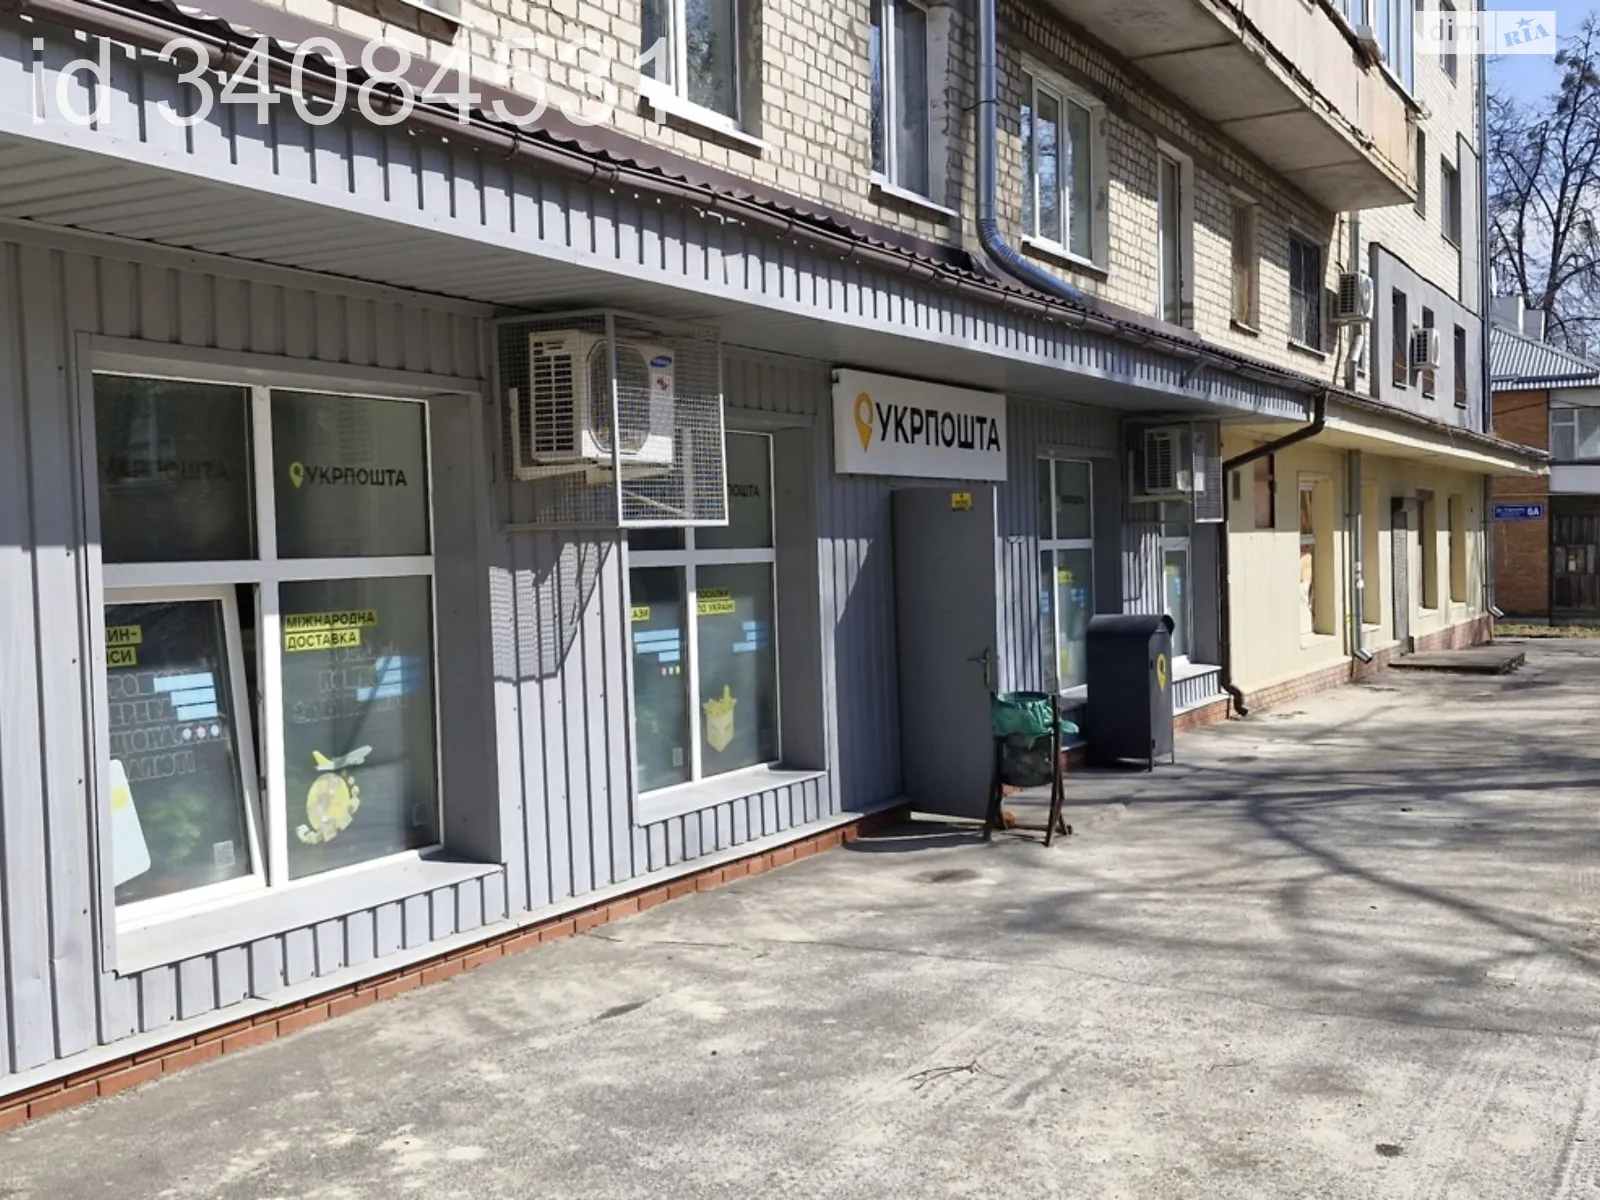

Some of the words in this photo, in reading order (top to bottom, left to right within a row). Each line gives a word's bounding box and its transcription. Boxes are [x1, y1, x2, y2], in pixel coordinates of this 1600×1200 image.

[875, 402, 1001, 452] УКРПОШТА
[305, 466, 408, 487] УКРПОШТА
[286, 611, 375, 629] МІЖНАРОДНА
[287, 632, 357, 649] ДОСТАВКА
